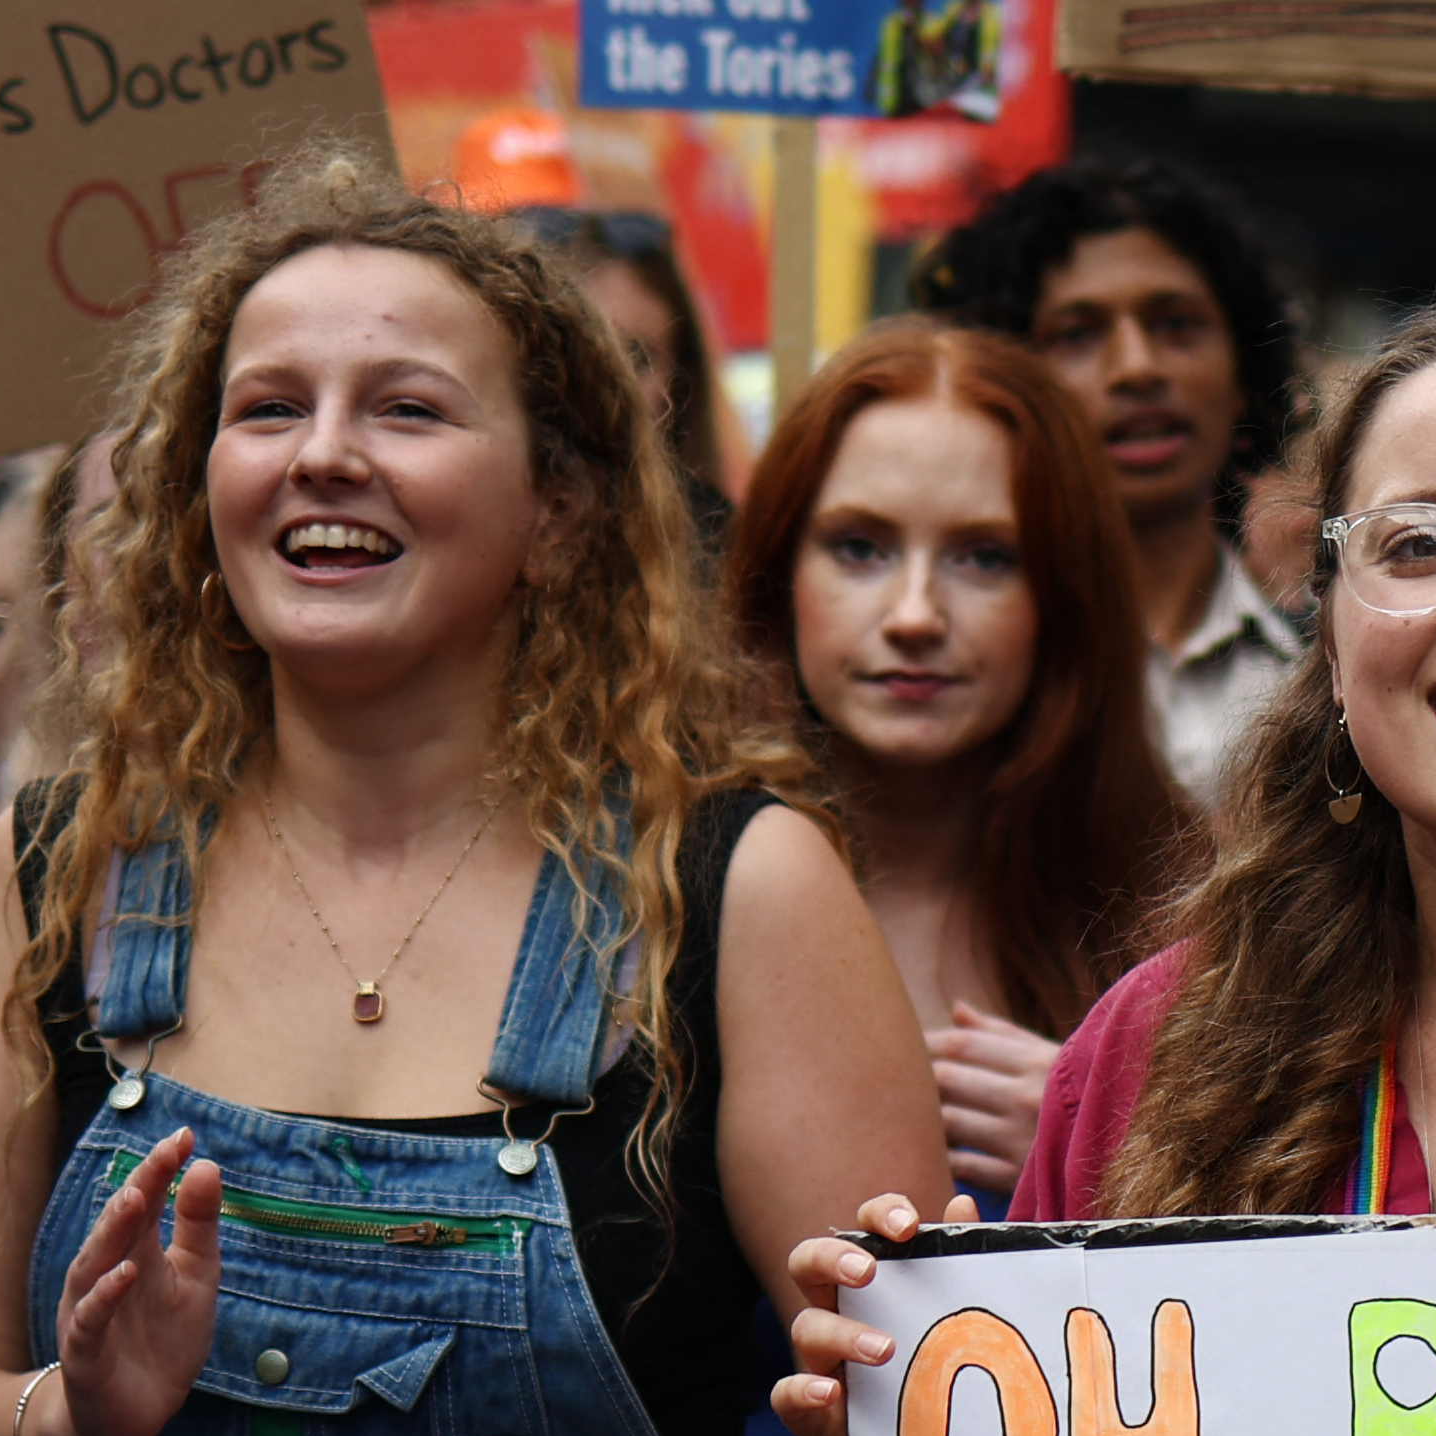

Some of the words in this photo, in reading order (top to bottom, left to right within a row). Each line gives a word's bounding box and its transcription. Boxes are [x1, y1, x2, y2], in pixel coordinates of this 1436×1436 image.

[47, 20, 348, 125] Doctors
[606, 27, 688, 93] the
[700, 29, 855, 99] Tories
